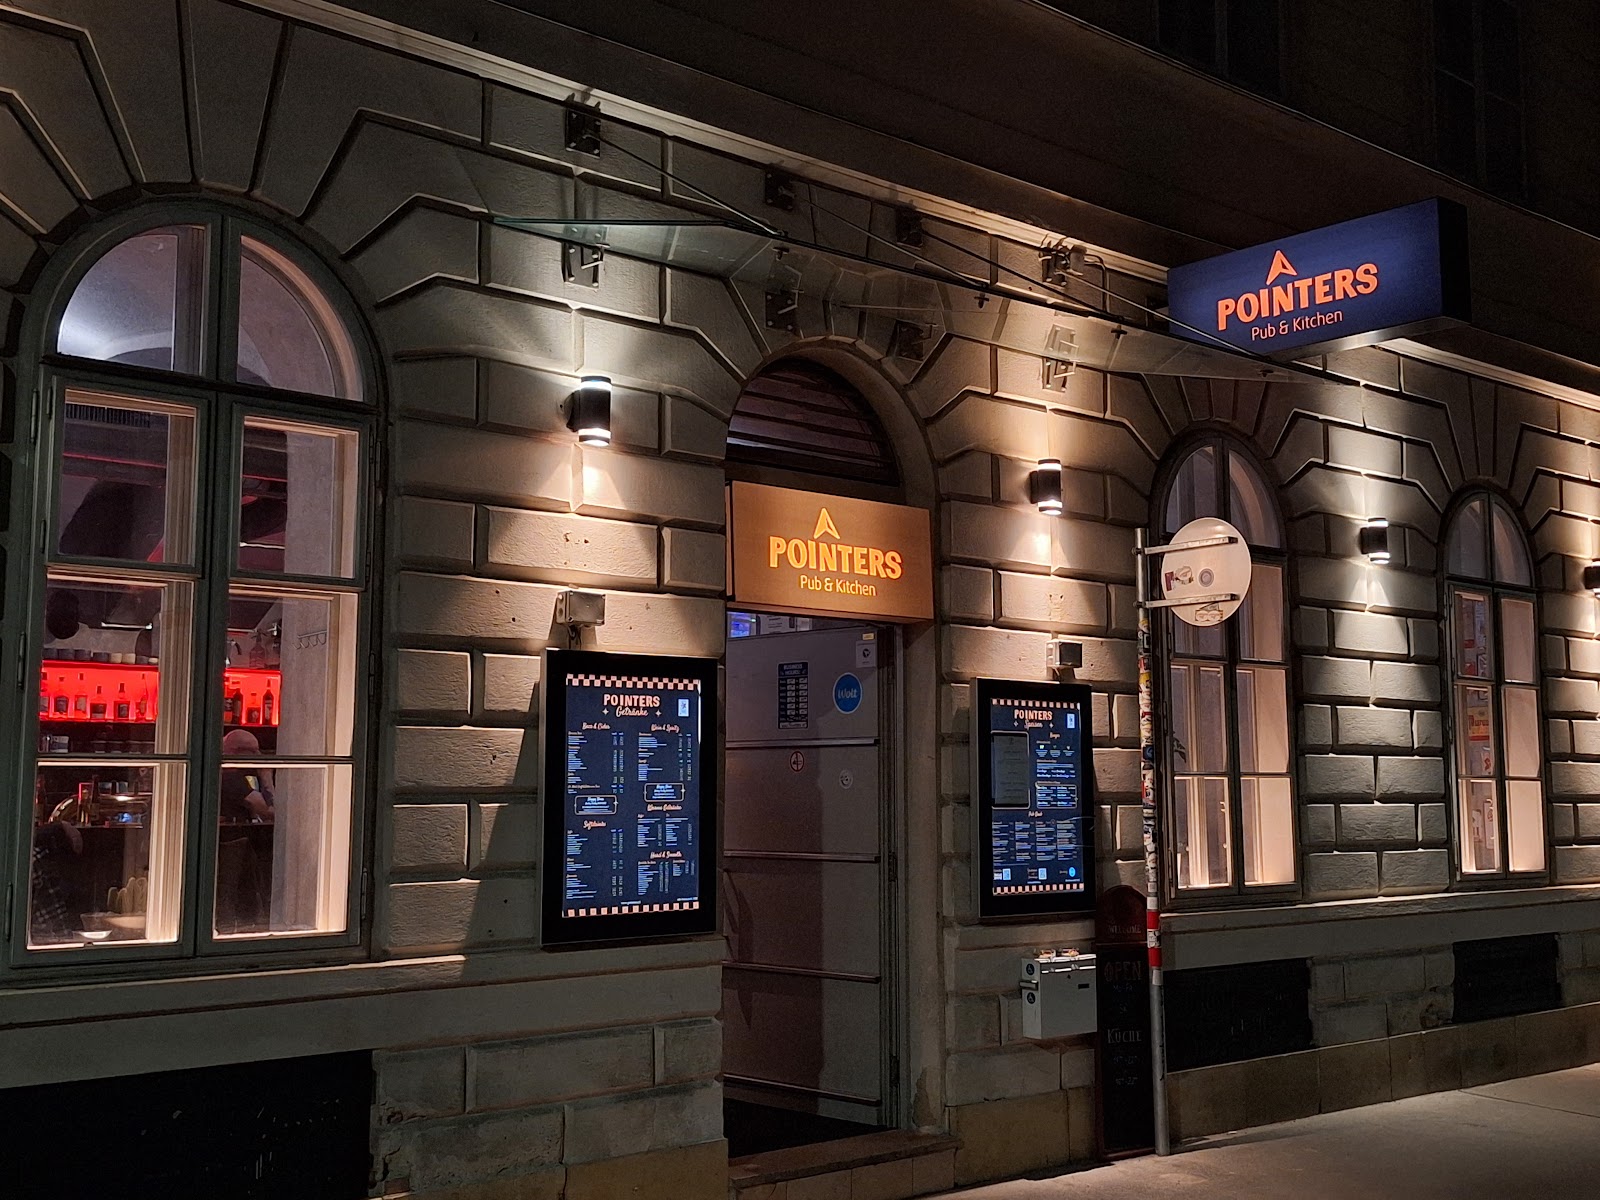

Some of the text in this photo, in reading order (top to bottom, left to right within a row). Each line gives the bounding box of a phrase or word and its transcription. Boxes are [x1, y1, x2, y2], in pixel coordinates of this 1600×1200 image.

[1217, 263, 1378, 331] POINTERS
[1251, 310, 1343, 341] Pub & Kitchen
[769, 535, 902, 579] POINTERS
[800, 574, 876, 597] Pub & Kitchen
[603, 694, 660, 707] POINTERS
[838, 687, 858, 699] Wolt
[615, 705, 648, 717] Getränke
[1013, 709, 1053, 720] POINTERS
[1104, 961, 1142, 982] OPEN
